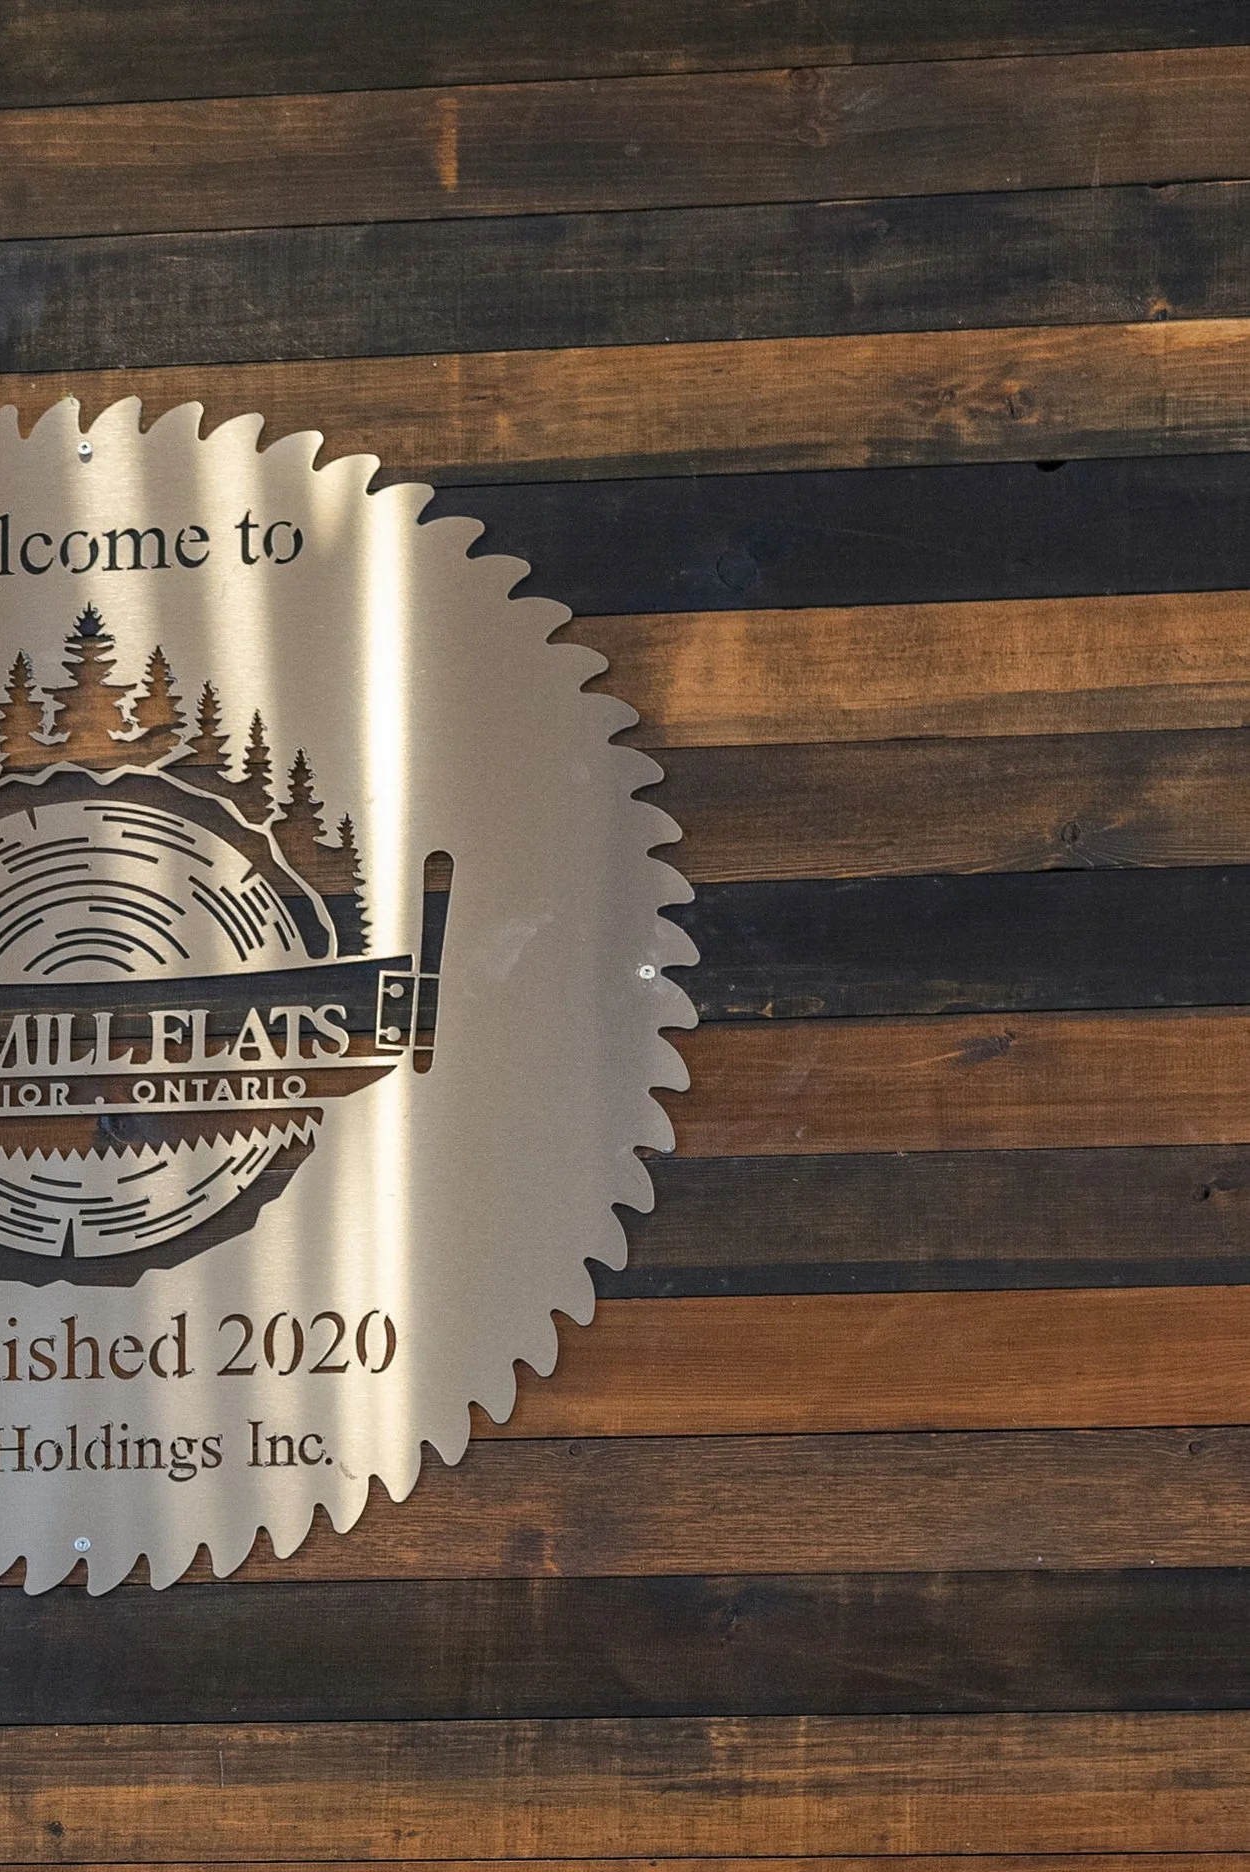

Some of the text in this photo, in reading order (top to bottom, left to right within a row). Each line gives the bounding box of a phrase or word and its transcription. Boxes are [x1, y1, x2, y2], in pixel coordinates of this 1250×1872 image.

[234, 508, 305, 566] to
[149, 1004, 350, 1063] FLATS
[132, 1075, 308, 1104] ONTARIO
[216, 1308, 397, 1377] 2020
[247, 1419, 334, 1468] Inc.
